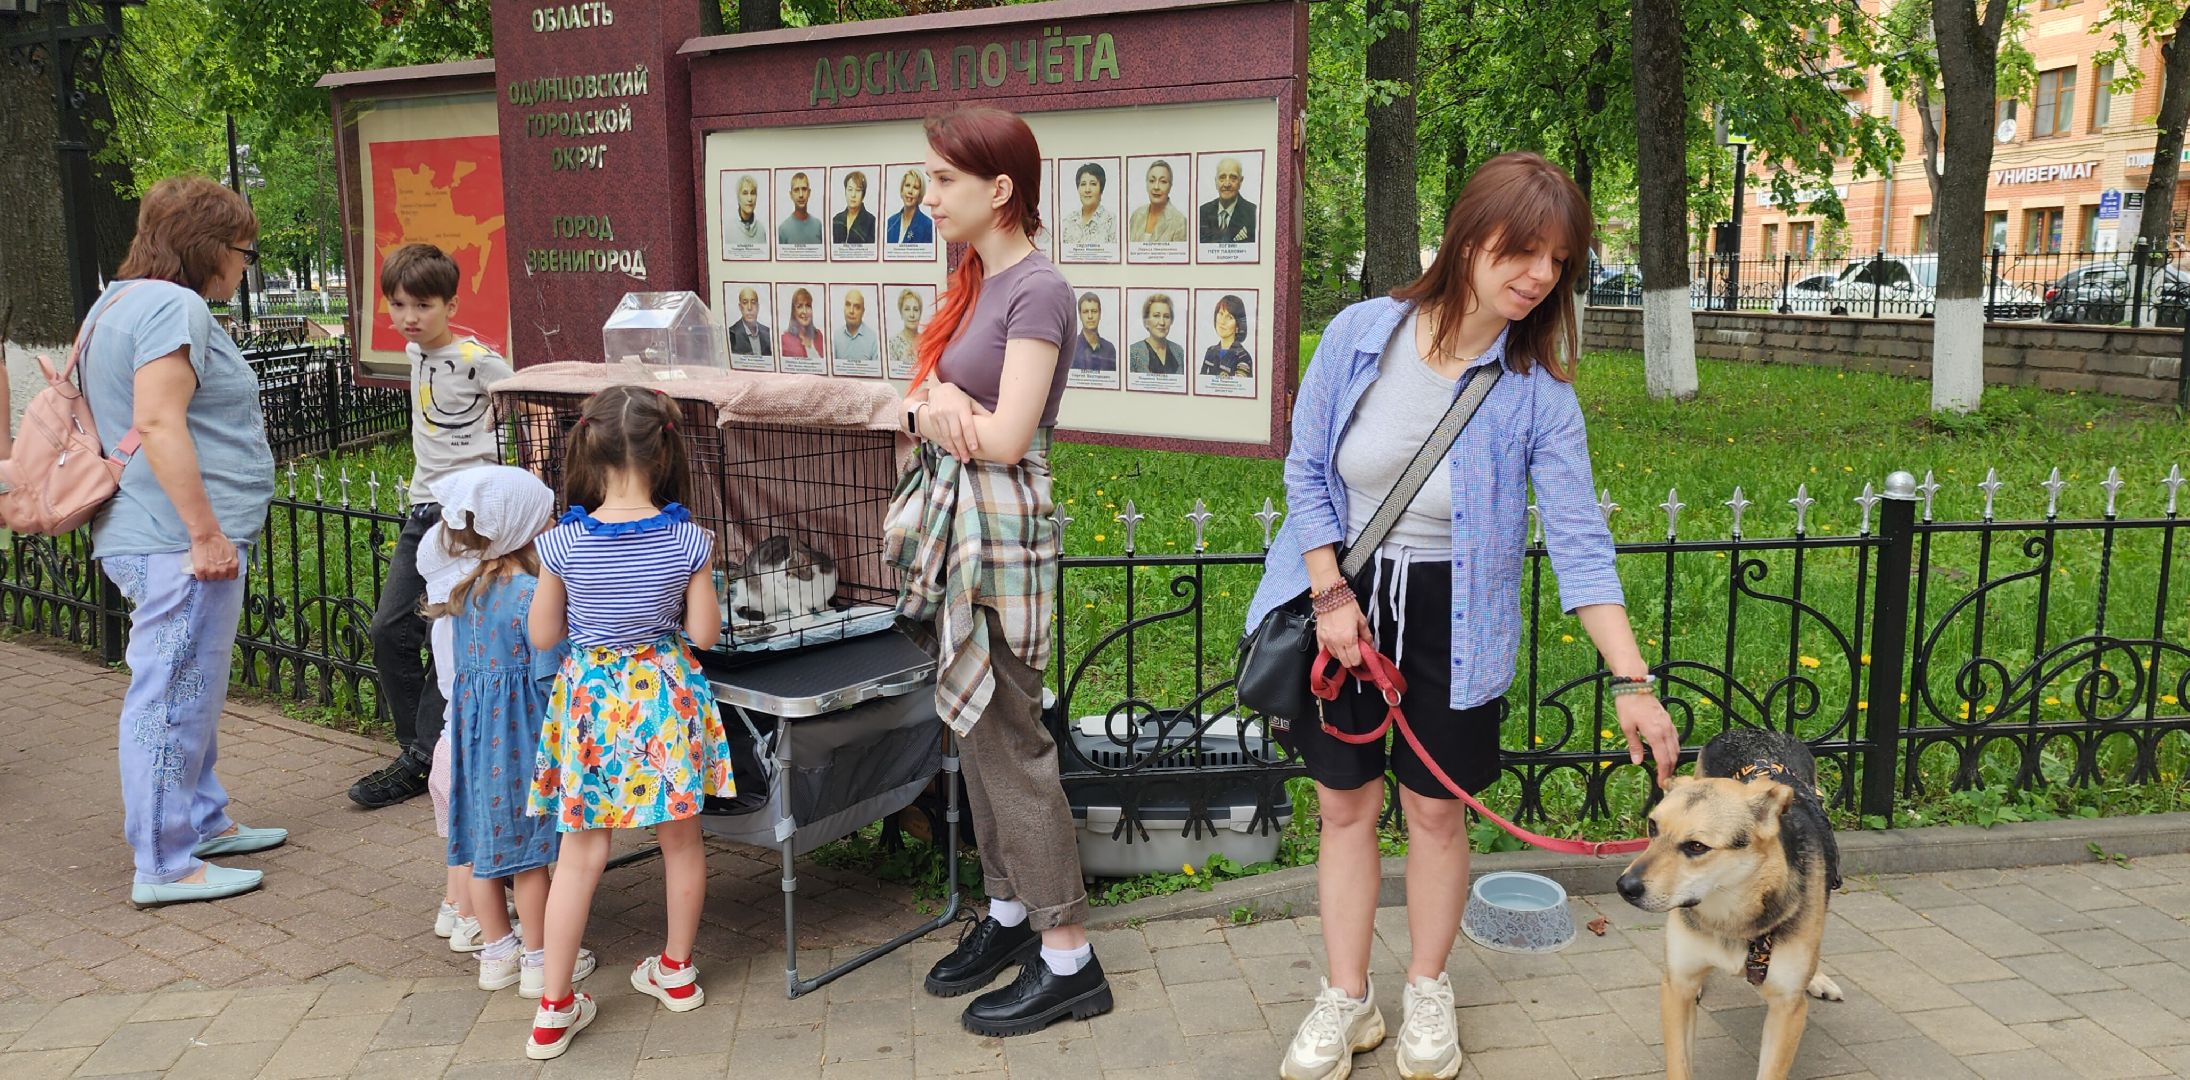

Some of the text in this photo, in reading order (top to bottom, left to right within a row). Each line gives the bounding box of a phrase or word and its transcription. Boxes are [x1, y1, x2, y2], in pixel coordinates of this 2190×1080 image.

[531, 2, 615, 33] ОБЛАСТЬ
[810, 26, 1120, 107] ДОСКА ПОЧЁТА
[508, 63, 649, 106] ОДИНЦОВСКИЙ
[526, 102, 633, 138] ГОРОДСКОЙ
[551, 144, 608, 171] ОКРУГ
[1994, 161, 2099, 185] УНИВЕРМАГ
[552, 214, 614, 242] ГОРОД
[526, 249, 648, 277] ЗВЕНИГОРОД
